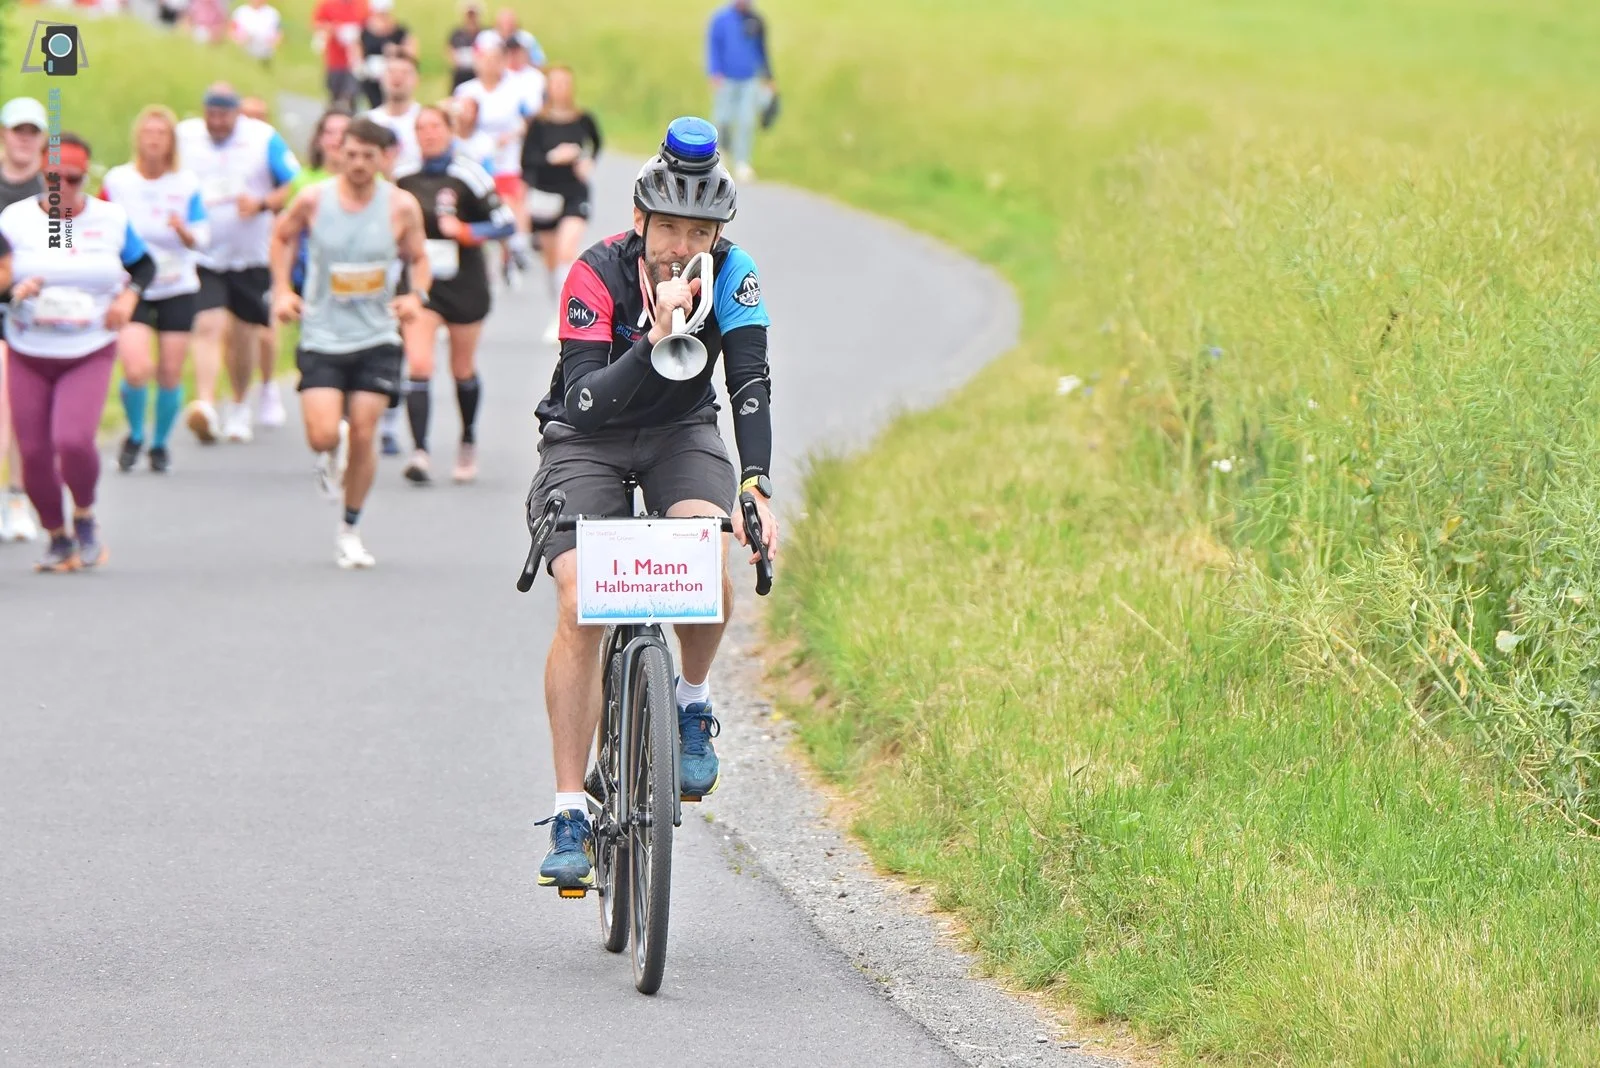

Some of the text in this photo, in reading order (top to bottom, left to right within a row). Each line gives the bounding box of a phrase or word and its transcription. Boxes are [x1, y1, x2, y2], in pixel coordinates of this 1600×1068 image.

[568, 307, 589, 320] GMK
[634, 558, 688, 576] Mann
[595, 580, 703, 593] Halbmarathon
